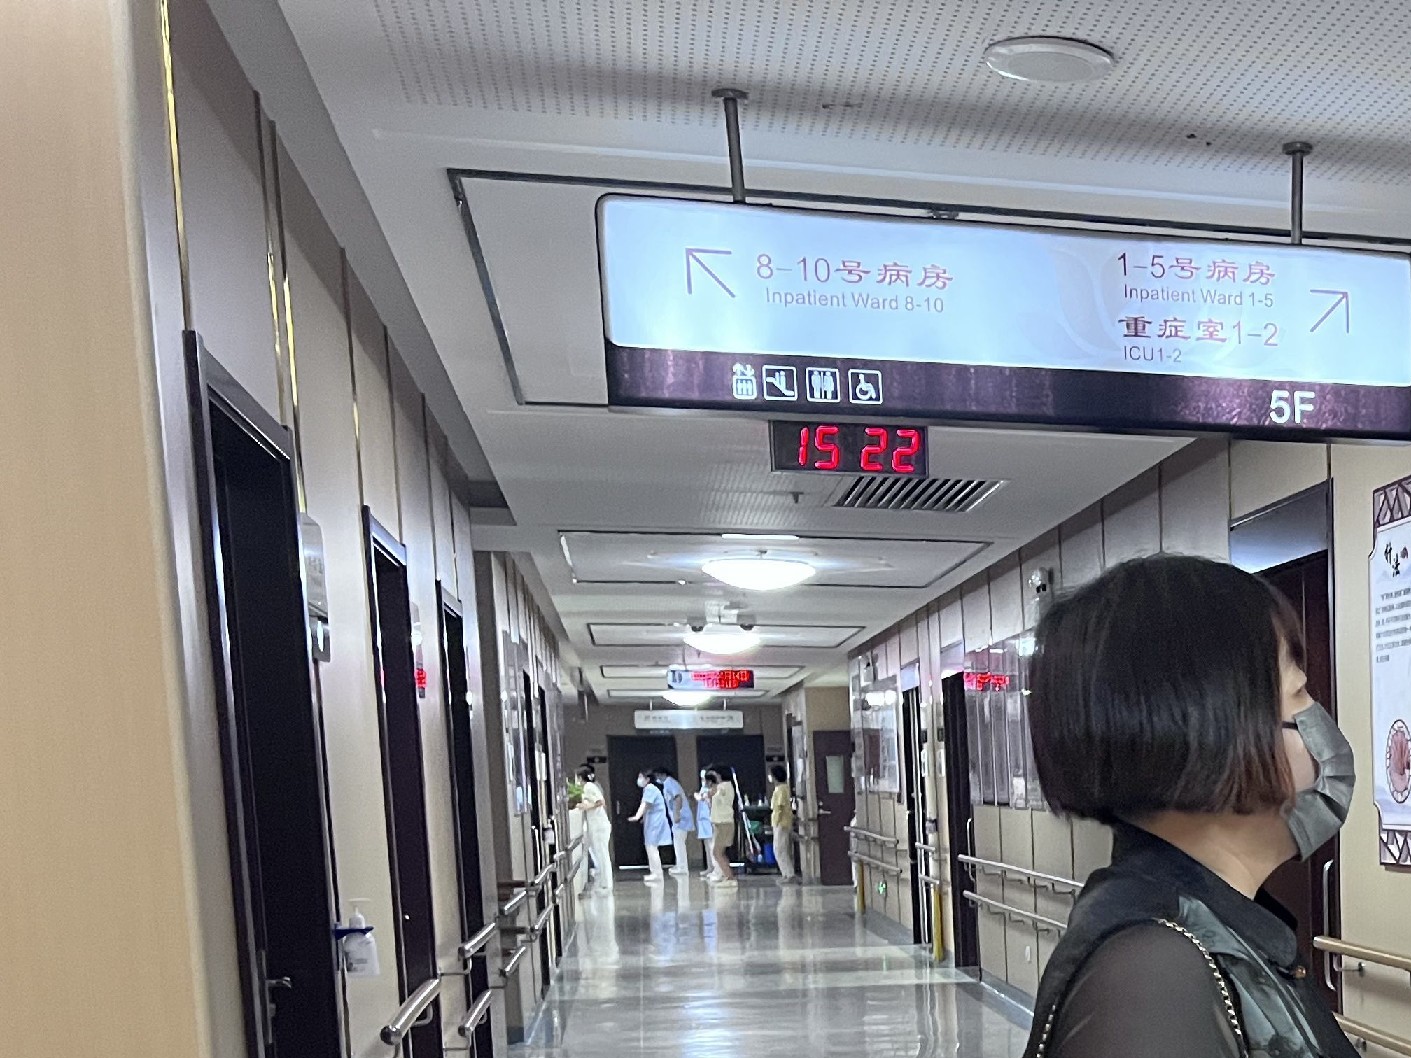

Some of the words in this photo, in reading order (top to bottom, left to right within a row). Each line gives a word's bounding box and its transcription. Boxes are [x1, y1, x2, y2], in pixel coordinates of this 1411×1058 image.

[757, 253, 953, 290] 8-10号病房
[1117, 252, 1275, 286] 1-5号病房
[766, 288, 848, 308] Inpatient
[851, 292, 899, 311] Ward
[905, 296, 944, 313] 8-10
[1124, 284, 1196, 303] Inpatient
[1200, 288, 1243, 306] Ward
[1248, 292, 1274, 308] 1-5
[1118, 315, 1279, 347] 重症室1-2
[1269, 390, 1315, 424] 5F
[798, 425, 840, 470] 15
[860, 427, 921, 473] 22
